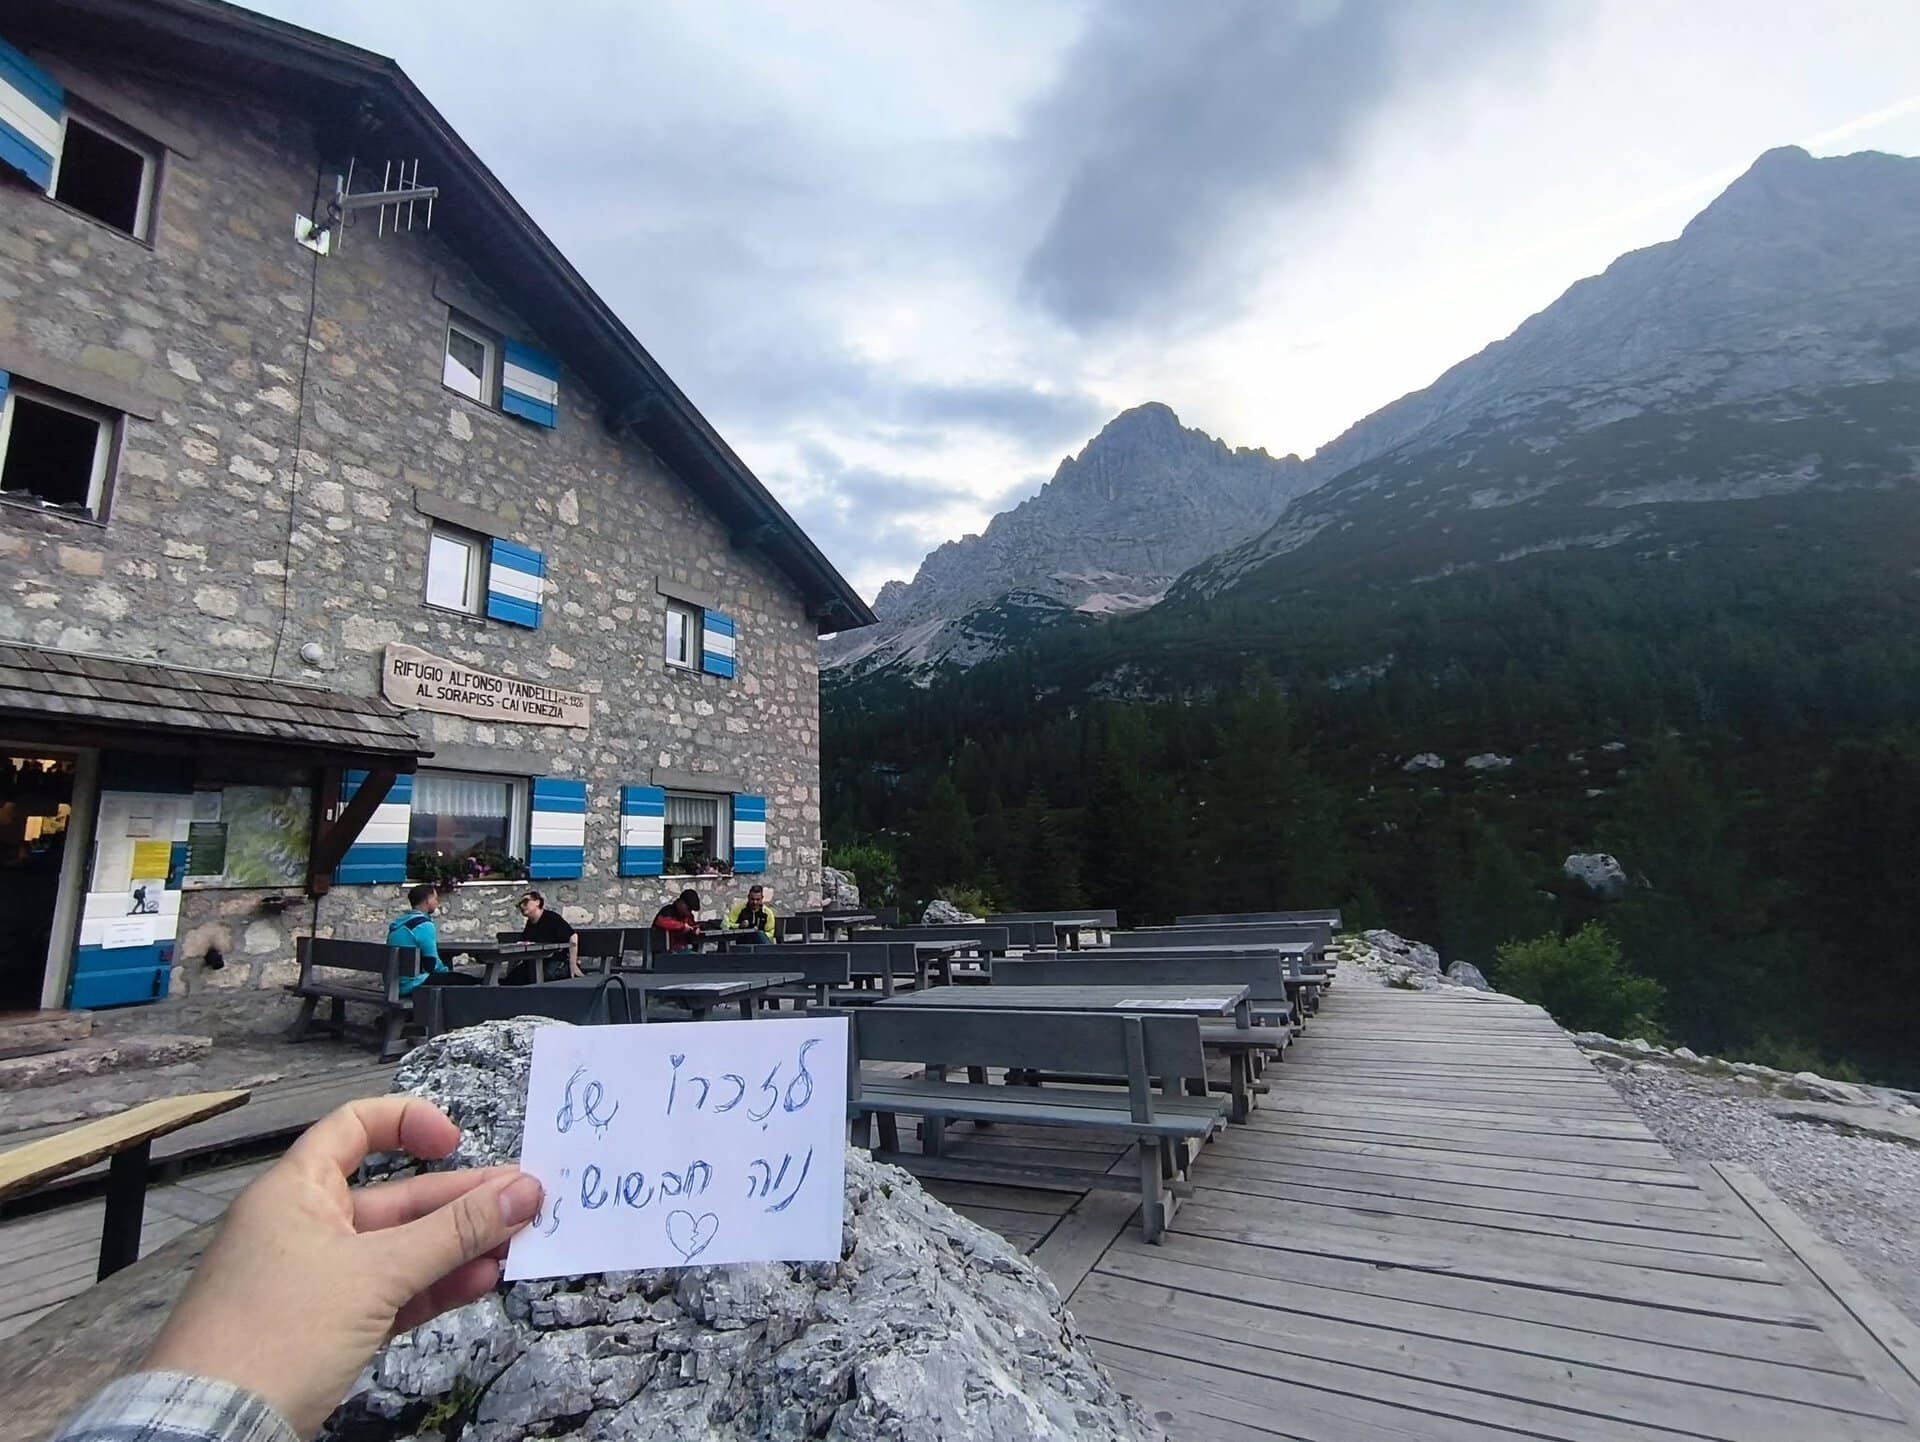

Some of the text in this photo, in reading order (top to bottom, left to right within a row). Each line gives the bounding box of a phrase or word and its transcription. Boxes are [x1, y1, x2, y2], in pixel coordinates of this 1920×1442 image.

[393, 659, 443, 682] RIFUGIO
[448, 671, 503, 693] ALFONSO
[508, 681, 558, 704] VANDELLI
[416, 683, 433, 698] AL
[436, 686, 495, 707] SORAPISS
[502, 697, 520, 712] CAI
[522, 700, 564, 719] VENEZIA
